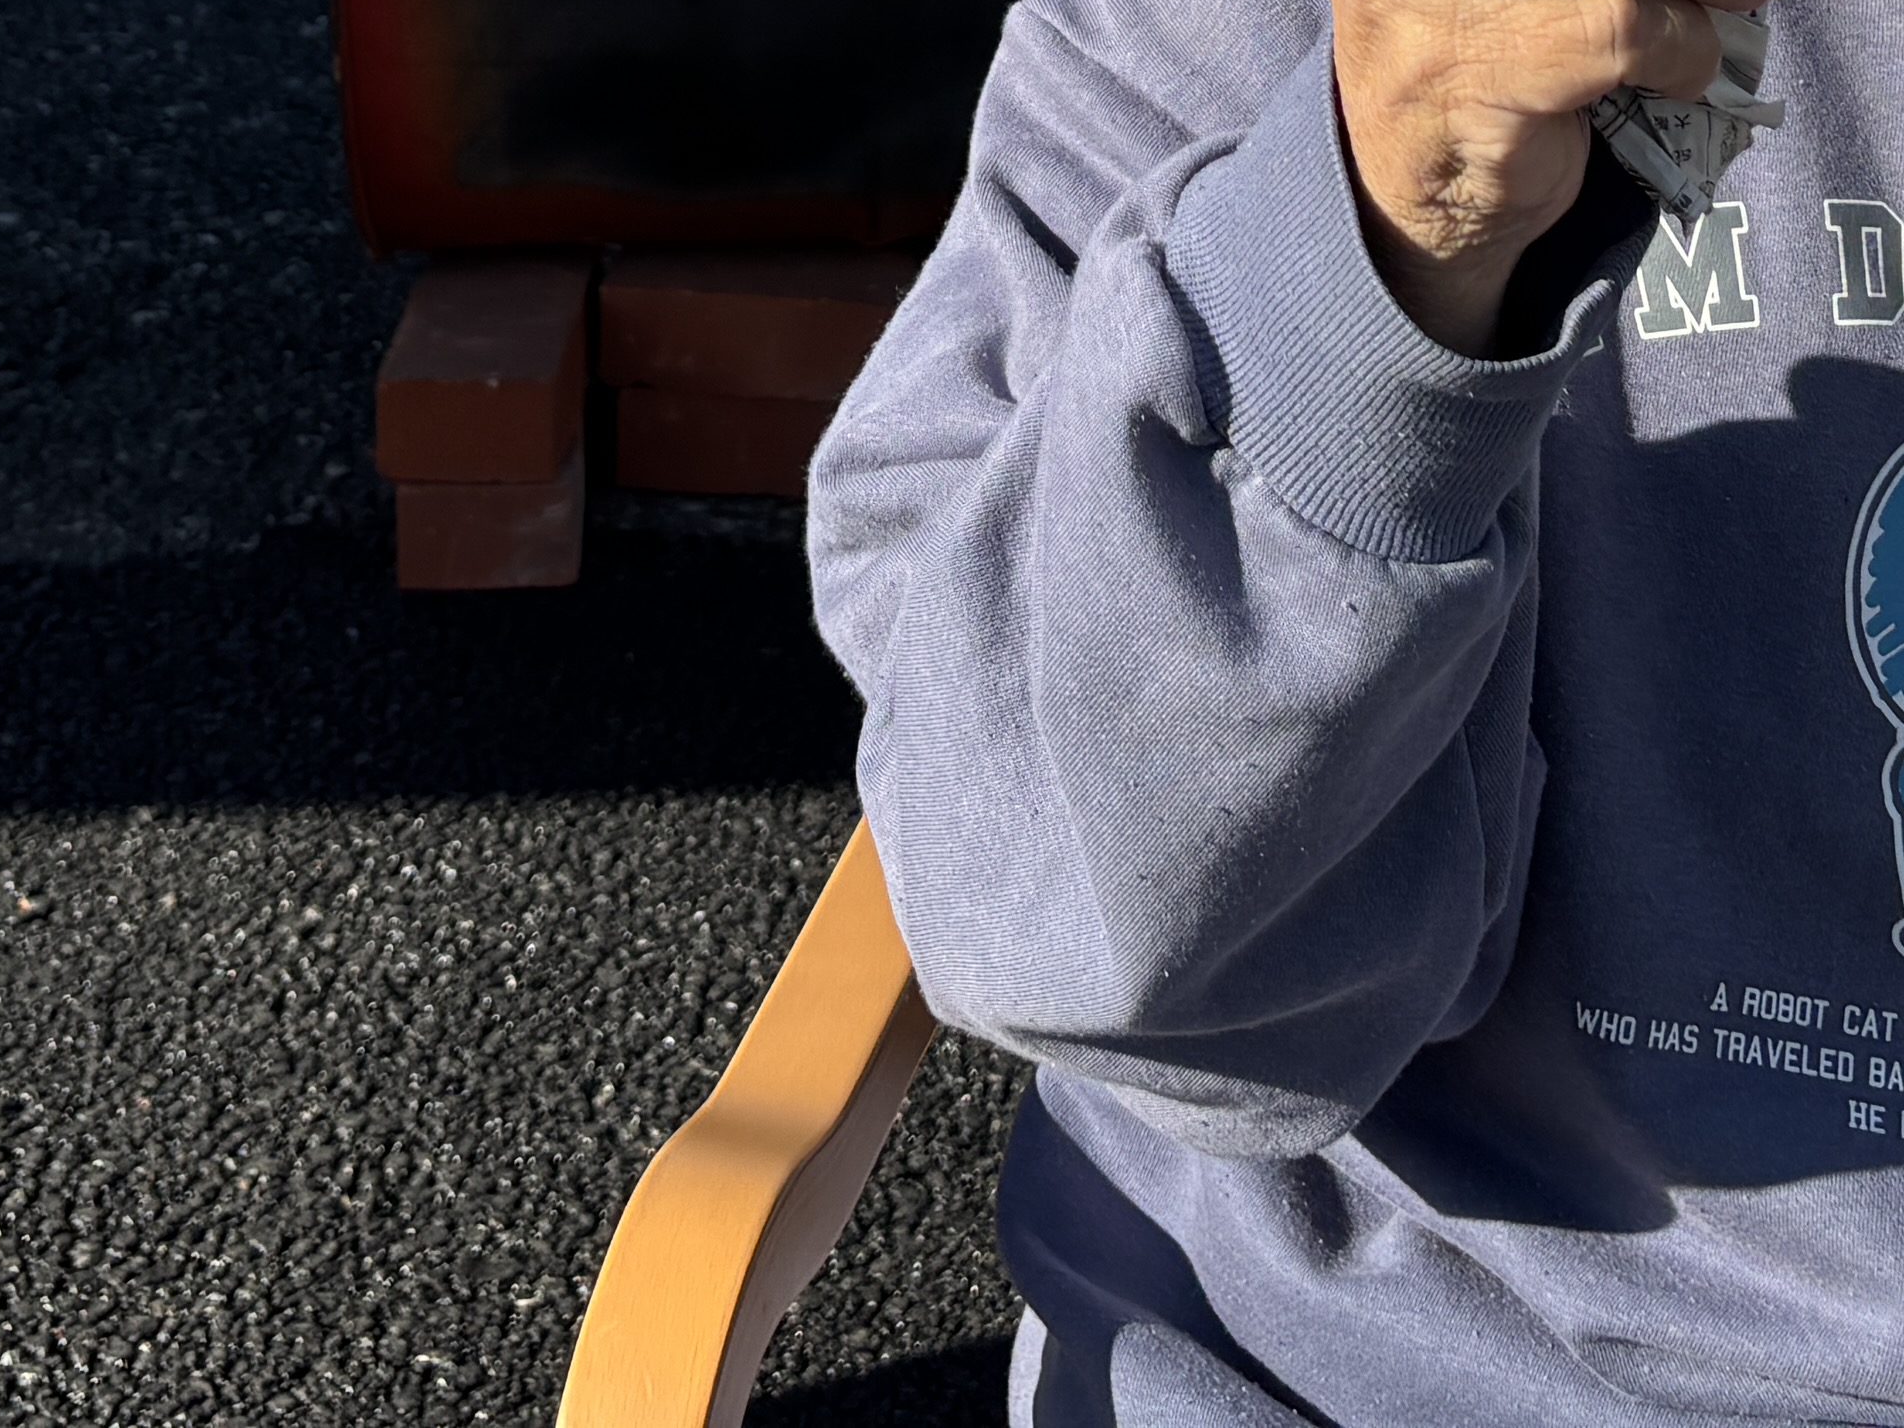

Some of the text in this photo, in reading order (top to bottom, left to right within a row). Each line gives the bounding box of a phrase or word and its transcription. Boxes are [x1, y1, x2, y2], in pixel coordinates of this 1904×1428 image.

[1575, 1001, 1637, 1046] WHO
[1647, 1019, 1699, 1054] HAS
[1713, 1027, 1855, 1083] TRAVELED
[1709, 982, 1729, 1013] A
[1741, 986, 1830, 1030] ROBOT
[1842, 1004, 1899, 1042] CAT
[1848, 1099, 1887, 1135] HE
